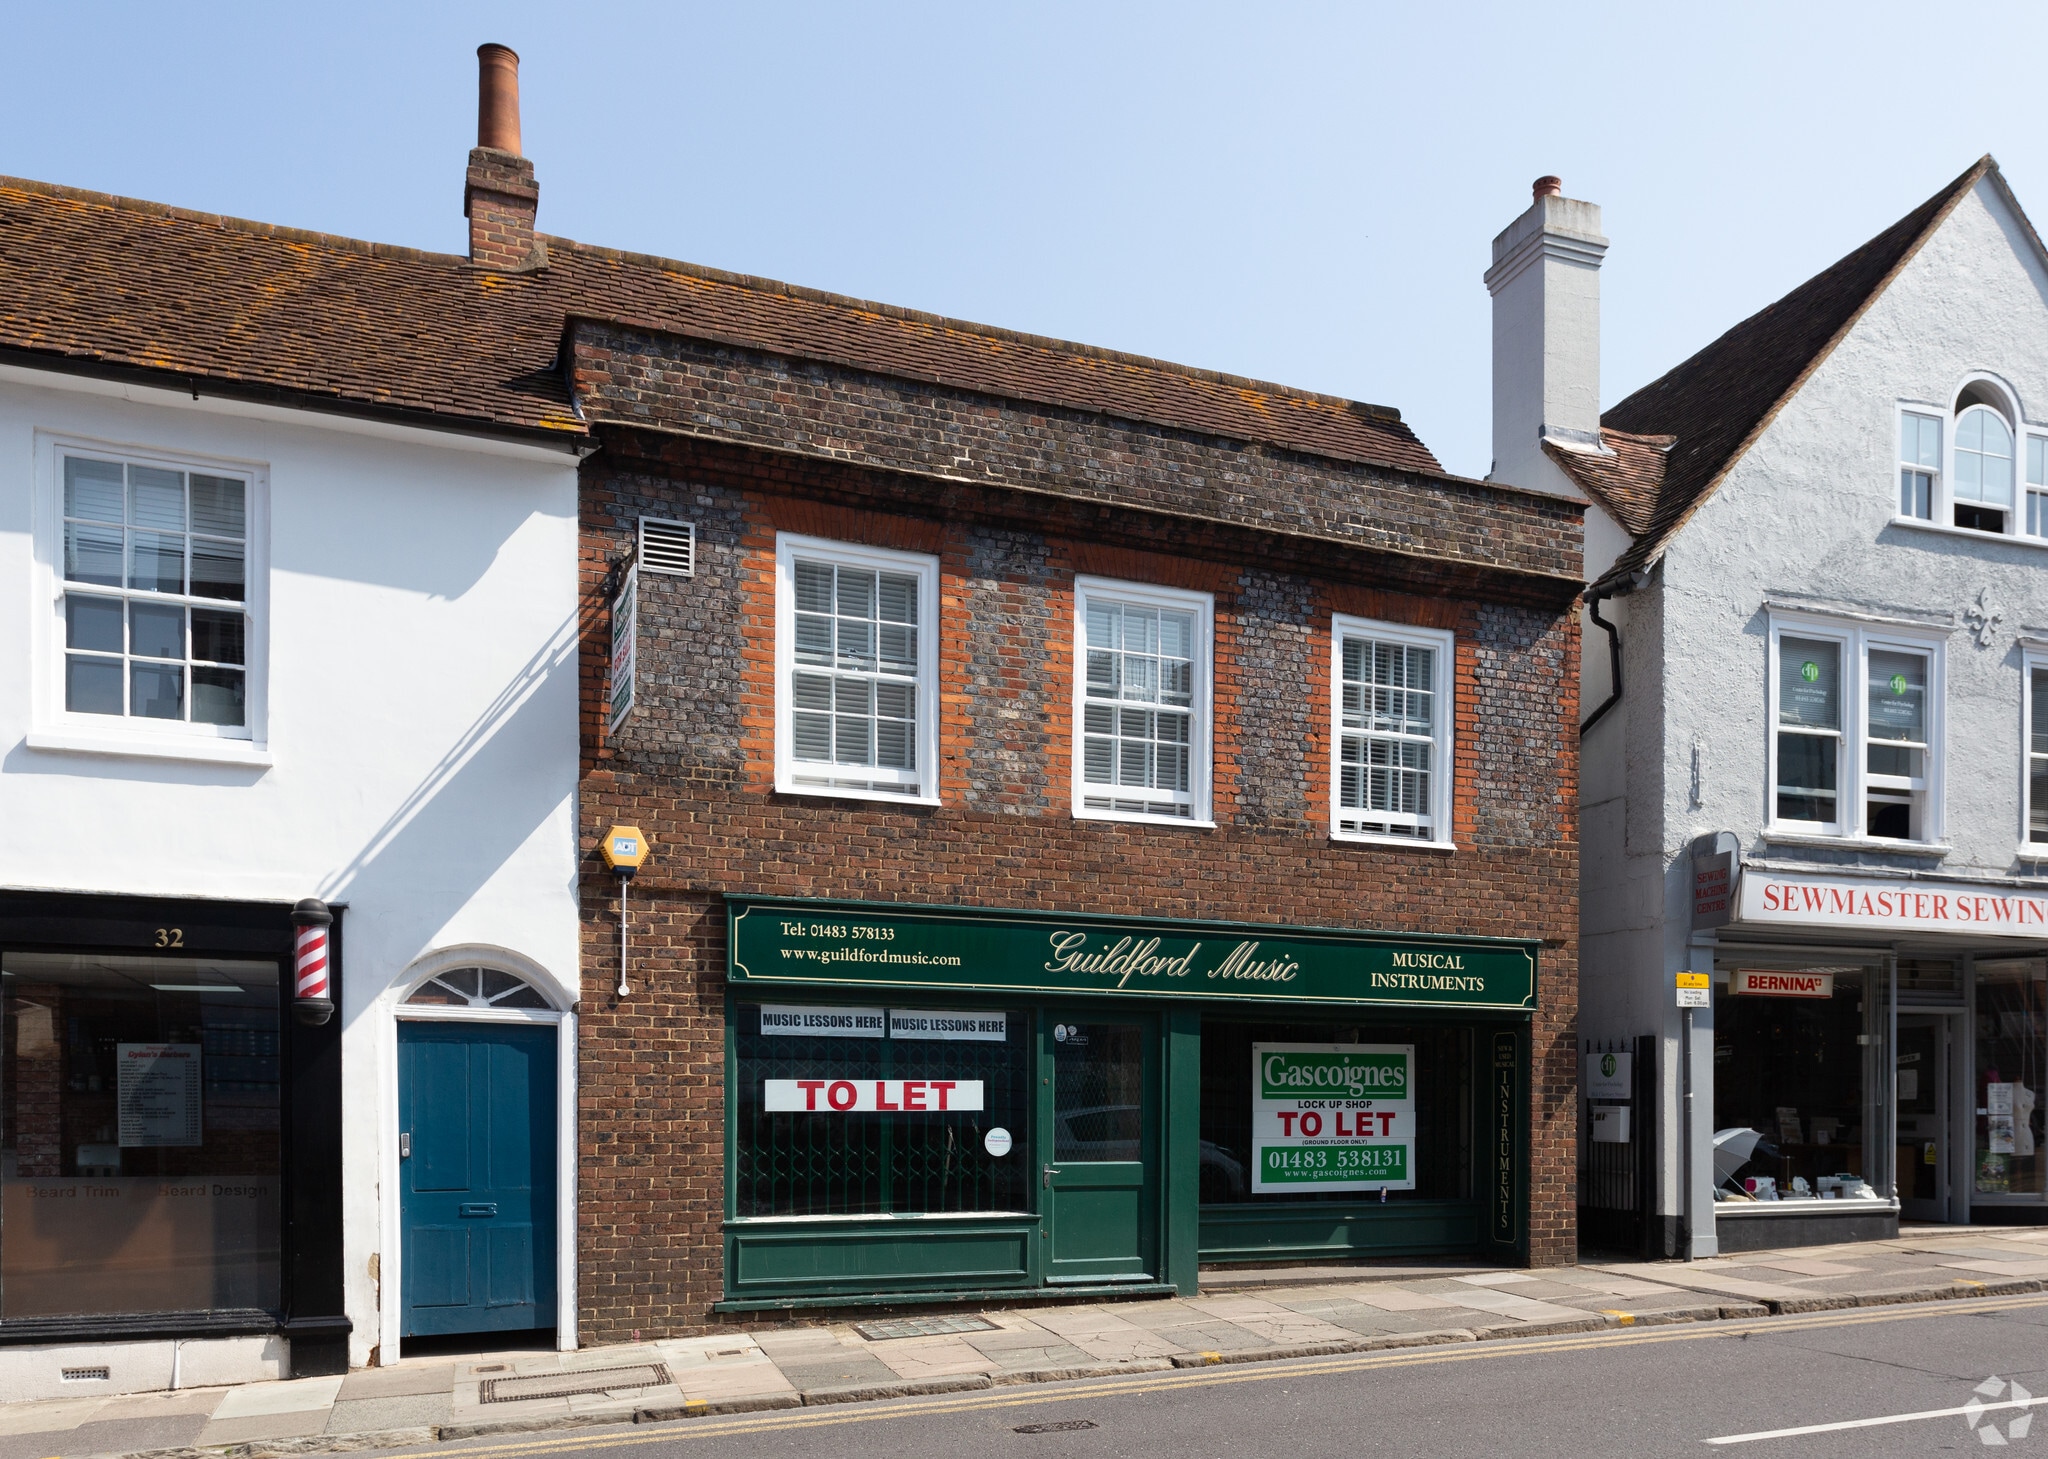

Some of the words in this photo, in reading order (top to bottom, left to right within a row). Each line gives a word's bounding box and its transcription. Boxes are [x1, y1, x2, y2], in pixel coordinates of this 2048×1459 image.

[614, 841, 637, 853] ADT
[1697, 867, 1727, 884] SEWING
[1695, 883, 1729, 899] MACHINE
[1696, 899, 1727, 915] CENTRE
[1762, 883, 1949, 920] SEWMASTER
[1956, 896, 2048, 925] SEWIN
[155, 928, 184, 948] 32
[780, 921, 806, 936] Tel:
[810, 924, 847, 938] 01483
[851, 926, 895, 941] 578133
[780, 948, 962, 966] www.guildfordmusic.com
[1044, 930, 1202, 989] Guildford
[1207, 940, 1300, 982] Music
[1392, 952, 1465, 970] MUSICAL
[1371, 972, 1485, 992] INSTRUMENTS
[1747, 974, 1816, 992] BERNINA
[762, 1013, 801, 1027] MUSIC
[803, 1014, 853, 1028] LESSONS
[855, 1016, 883, 1029] HERE
[891, 1017, 928, 1031] MUSIC
[930, 1018, 976, 1033] LESSONS
[978, 1020, 1004, 1033] HERE
[1264, 1055, 1405, 1097] Gascoignes
[797, 1080, 858, 1111] TO
[875, 1081, 956, 1111] LET
[1297, 1100, 1326, 1109] LOCK
[1328, 1100, 1343, 1109] UP
[1345, 1100, 1373, 1109] SHOP
[1277, 1111, 1323, 1137] TO
[1335, 1111, 1396, 1137] LET
[1500, 1070, 1510, 1229] INSTRUMENTS
[1268, 1151, 1327, 1169] 01483
[1336, 1150, 1402, 1168] 538131
[1284, 1167, 1387, 1180] www.gascoignes.com
[26, 1185, 77, 1199] Beard
[82, 1185, 120, 1199] Trim
[158, 1184, 206, 1198] Beard
[212, 1183, 268, 1199] Design
